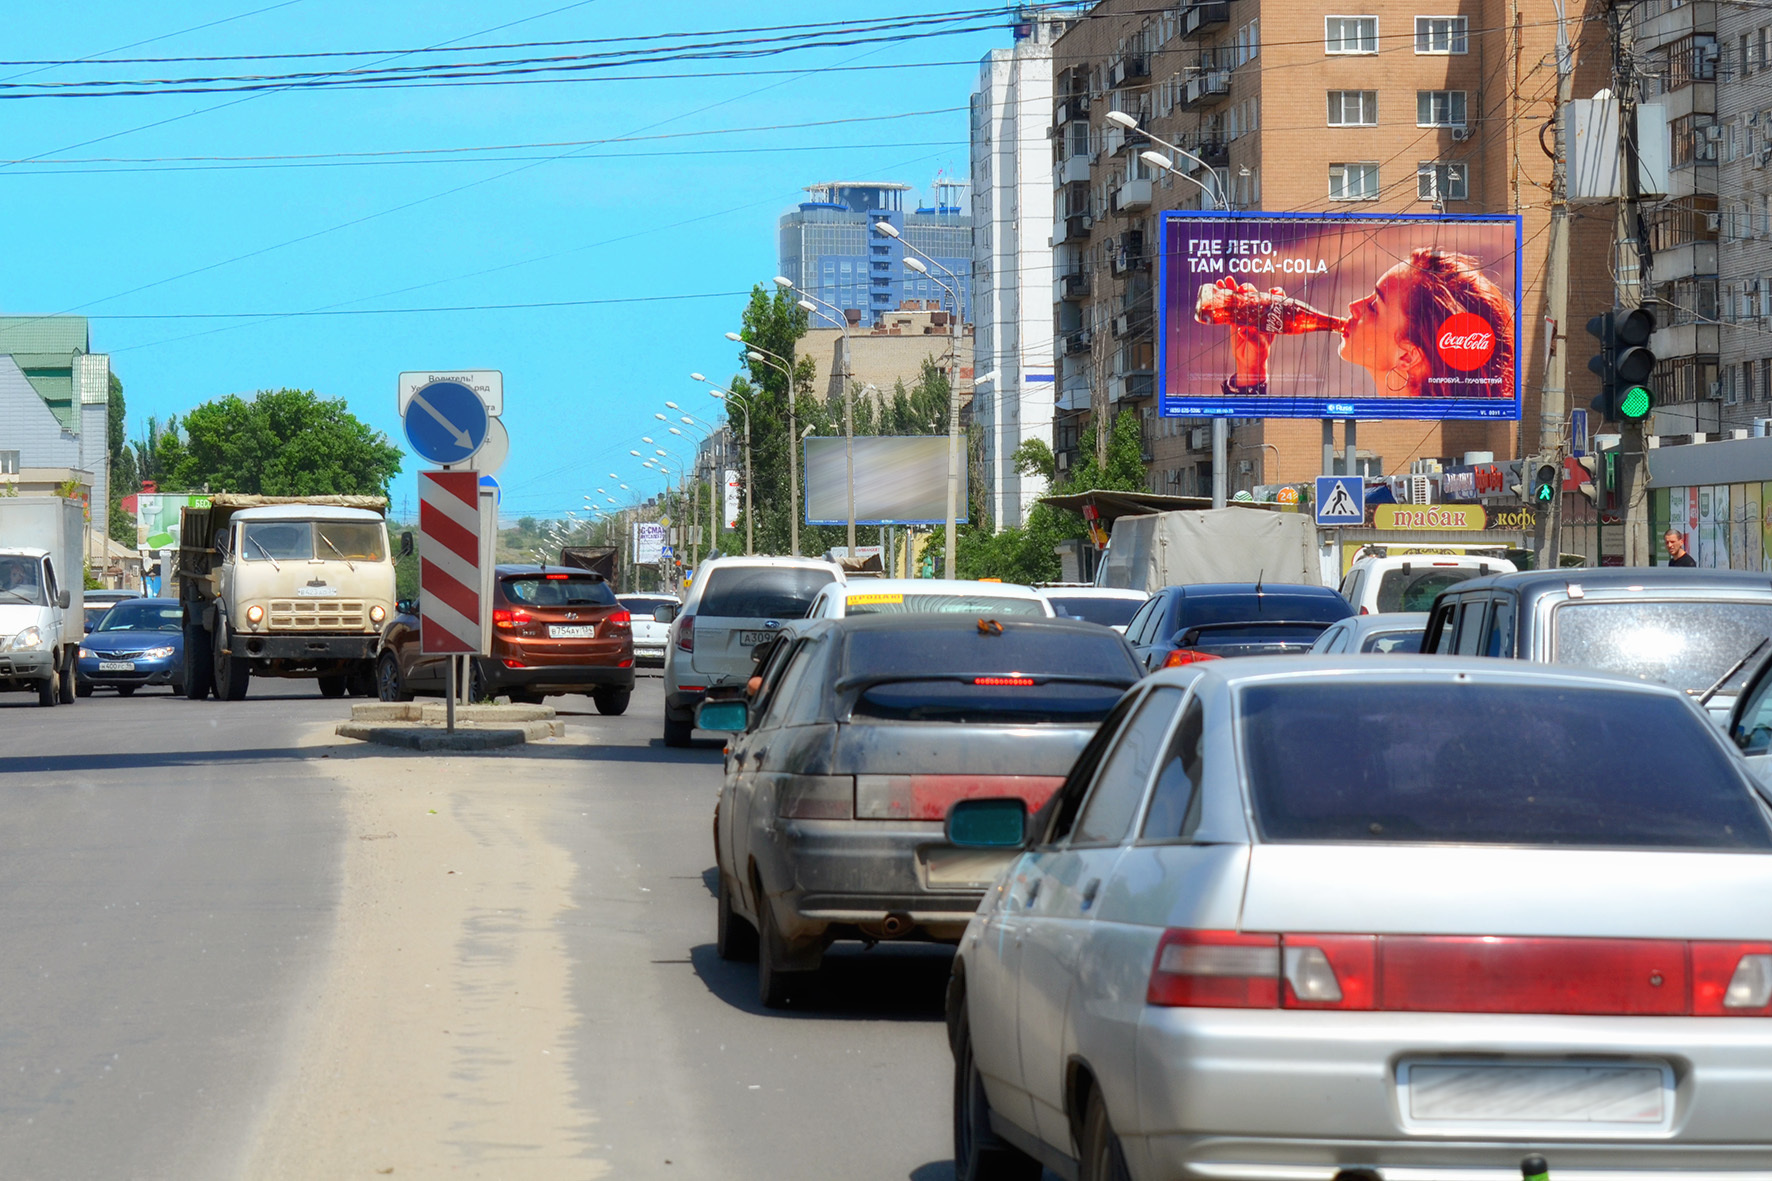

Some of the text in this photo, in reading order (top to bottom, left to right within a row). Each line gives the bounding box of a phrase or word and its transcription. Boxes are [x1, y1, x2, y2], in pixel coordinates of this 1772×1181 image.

[1188, 239, 1277, 257] ГДЕ ЛЕТО,
[1187, 258, 1328, 273] ТАМ COCA-COLA
[1280, 492, 1293, 501] 24
[1392, 505, 1467, 530] табак
